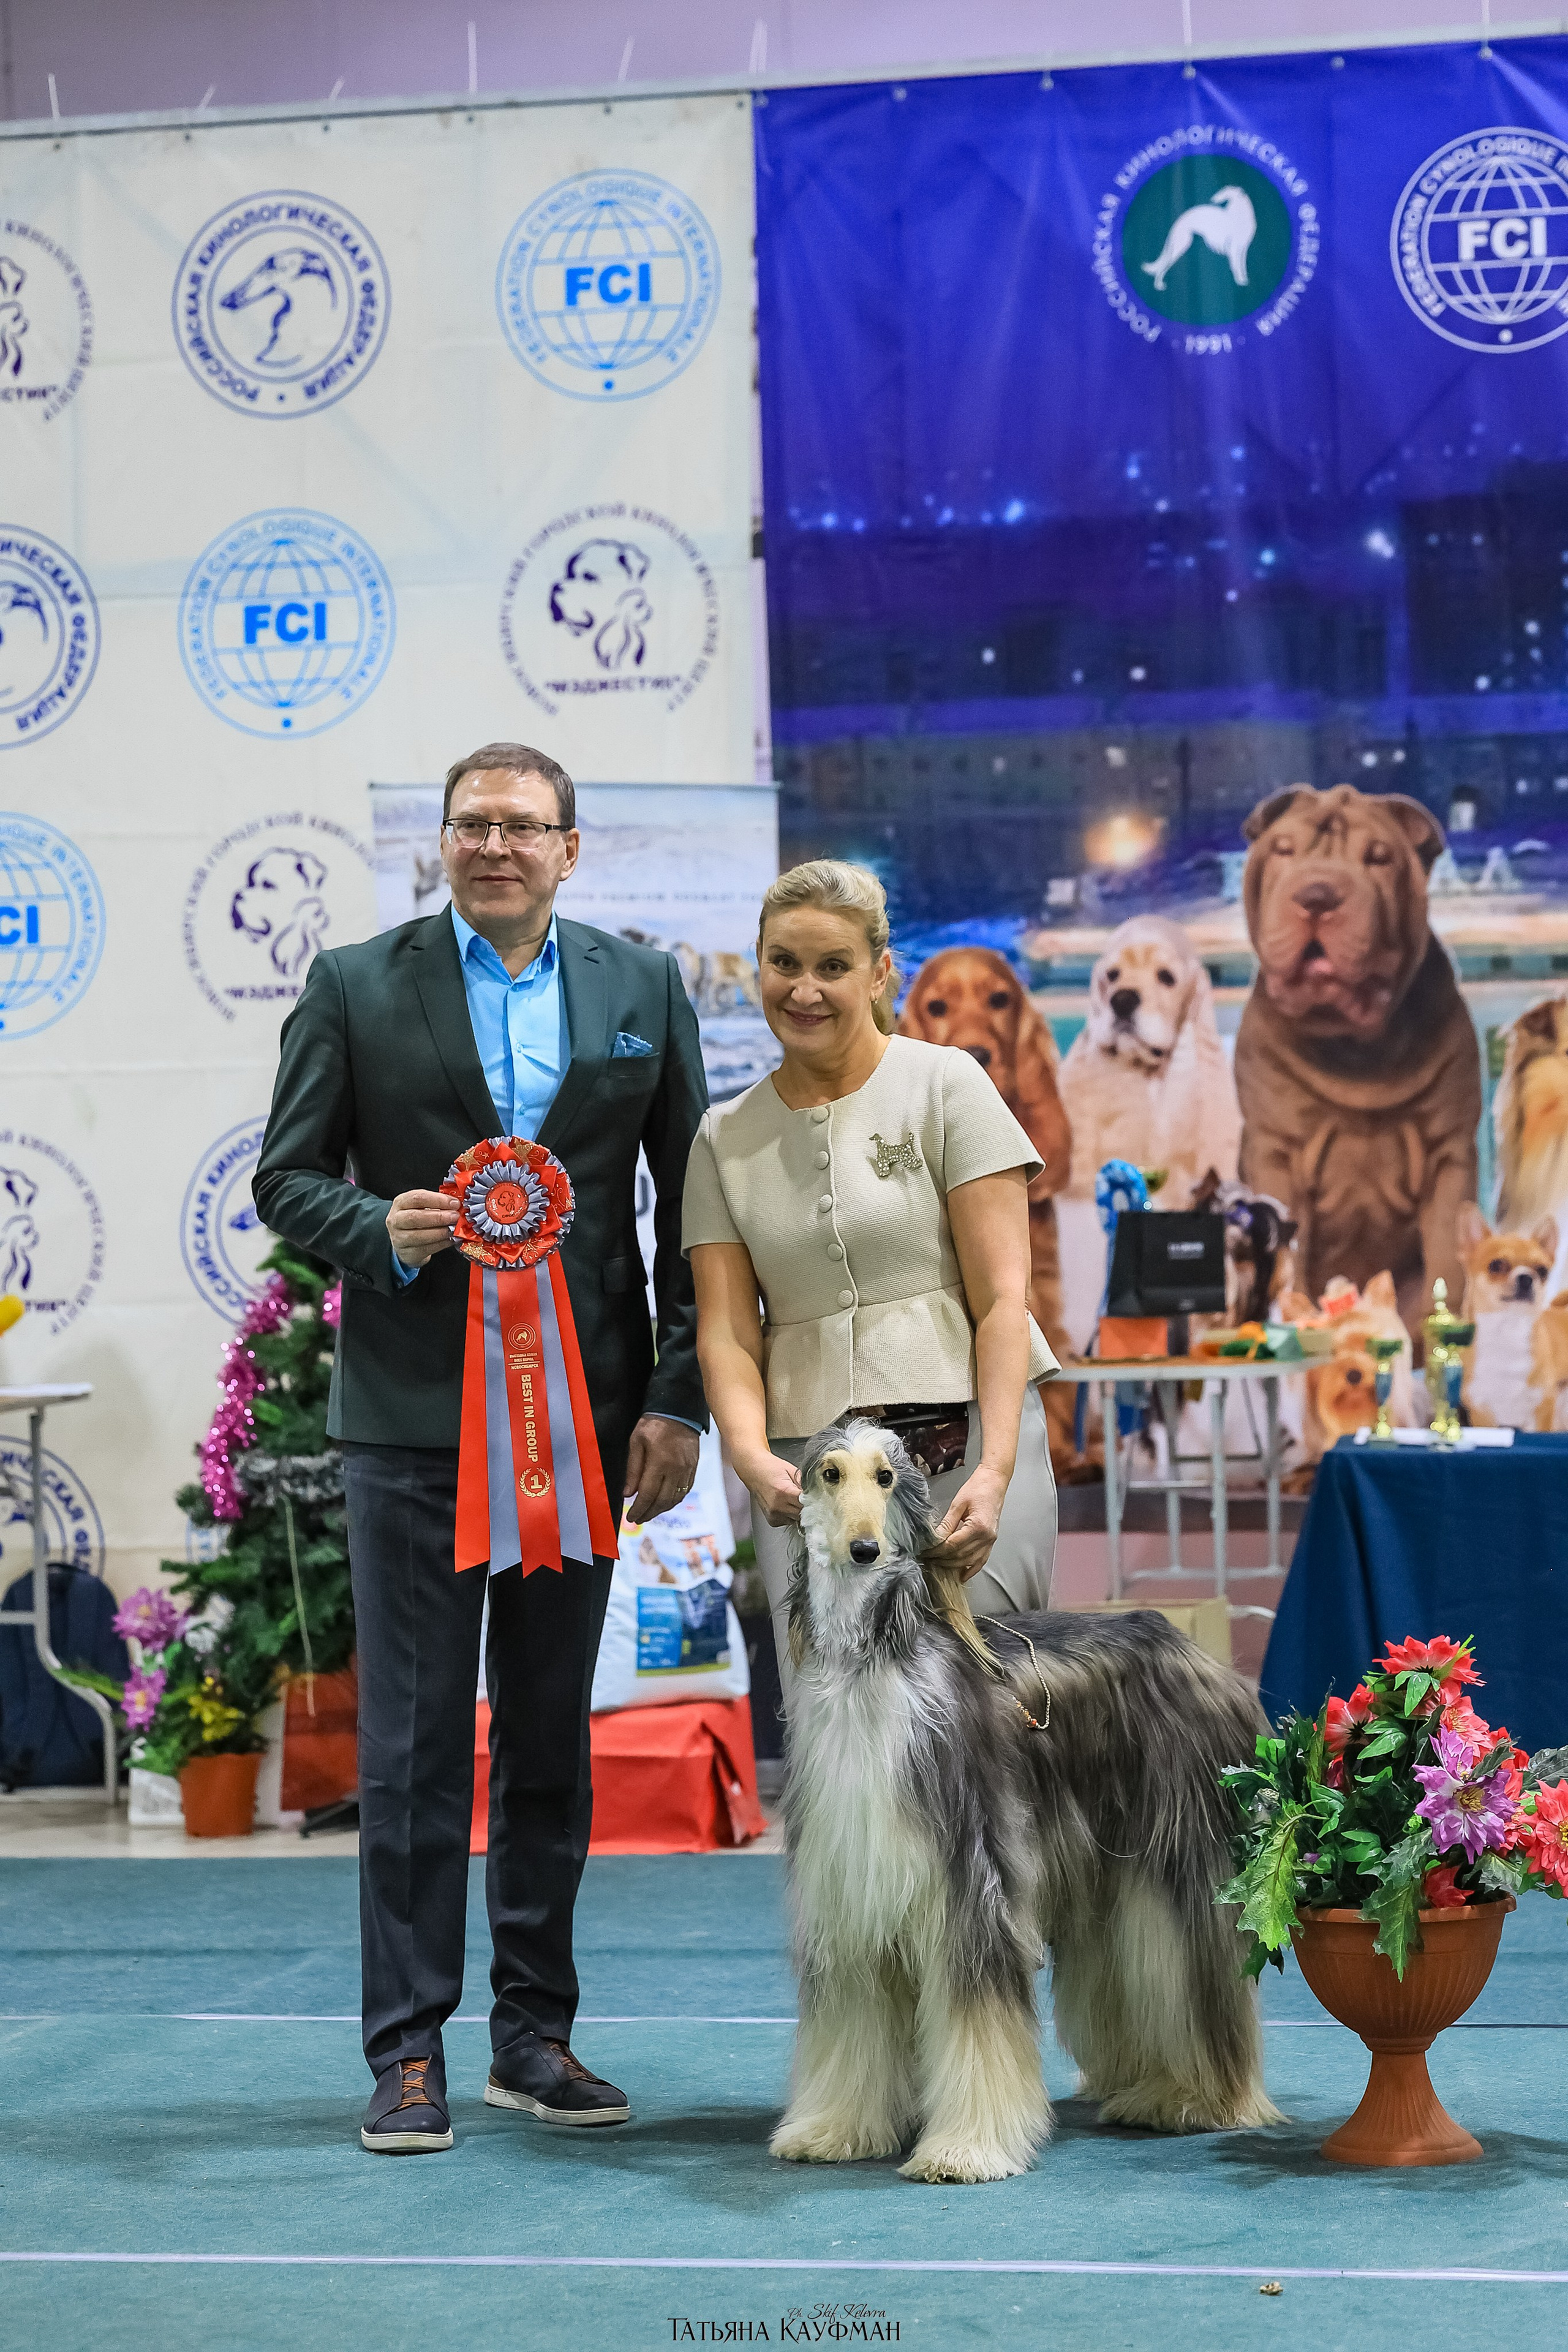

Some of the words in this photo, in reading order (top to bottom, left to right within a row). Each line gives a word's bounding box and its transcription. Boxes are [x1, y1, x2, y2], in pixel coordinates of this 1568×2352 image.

[1113, 124, 1308, 197] КИНОЛОГИЧЕСКАЯ
[198, 205, 371, 273] КИНОЛОГИЧЕСКАЯ
[1458, 216, 1547, 262] FCI
[565, 262, 651, 307] FCI
[1092, 193, 1161, 343] РОССИЙСКАЯ
[1256, 203, 1320, 336] ФЕДЕРАЦИЯ
[186, 273, 260, 401] РОССИЙСКАЯ
[303, 278, 378, 399] ФЕДЕРАЦИЯ
[1185, 333, 1232, 355] 1991
[0, 539, 83, 605] ИЧЕСКАЯ
[244, 601, 327, 645] FCI
[16, 613, 88, 731] ФЕДЕРАЦИЯ
[0, 905, 39, 945] CI
[193, 1191, 244, 1308] ССИЙСКАЯ
[521, 1374, 533, 1403] BEST
[524, 1405, 535, 1418] IN
[525, 1420, 538, 1463] GROUP
[530, 1474, 543, 1490] 1
